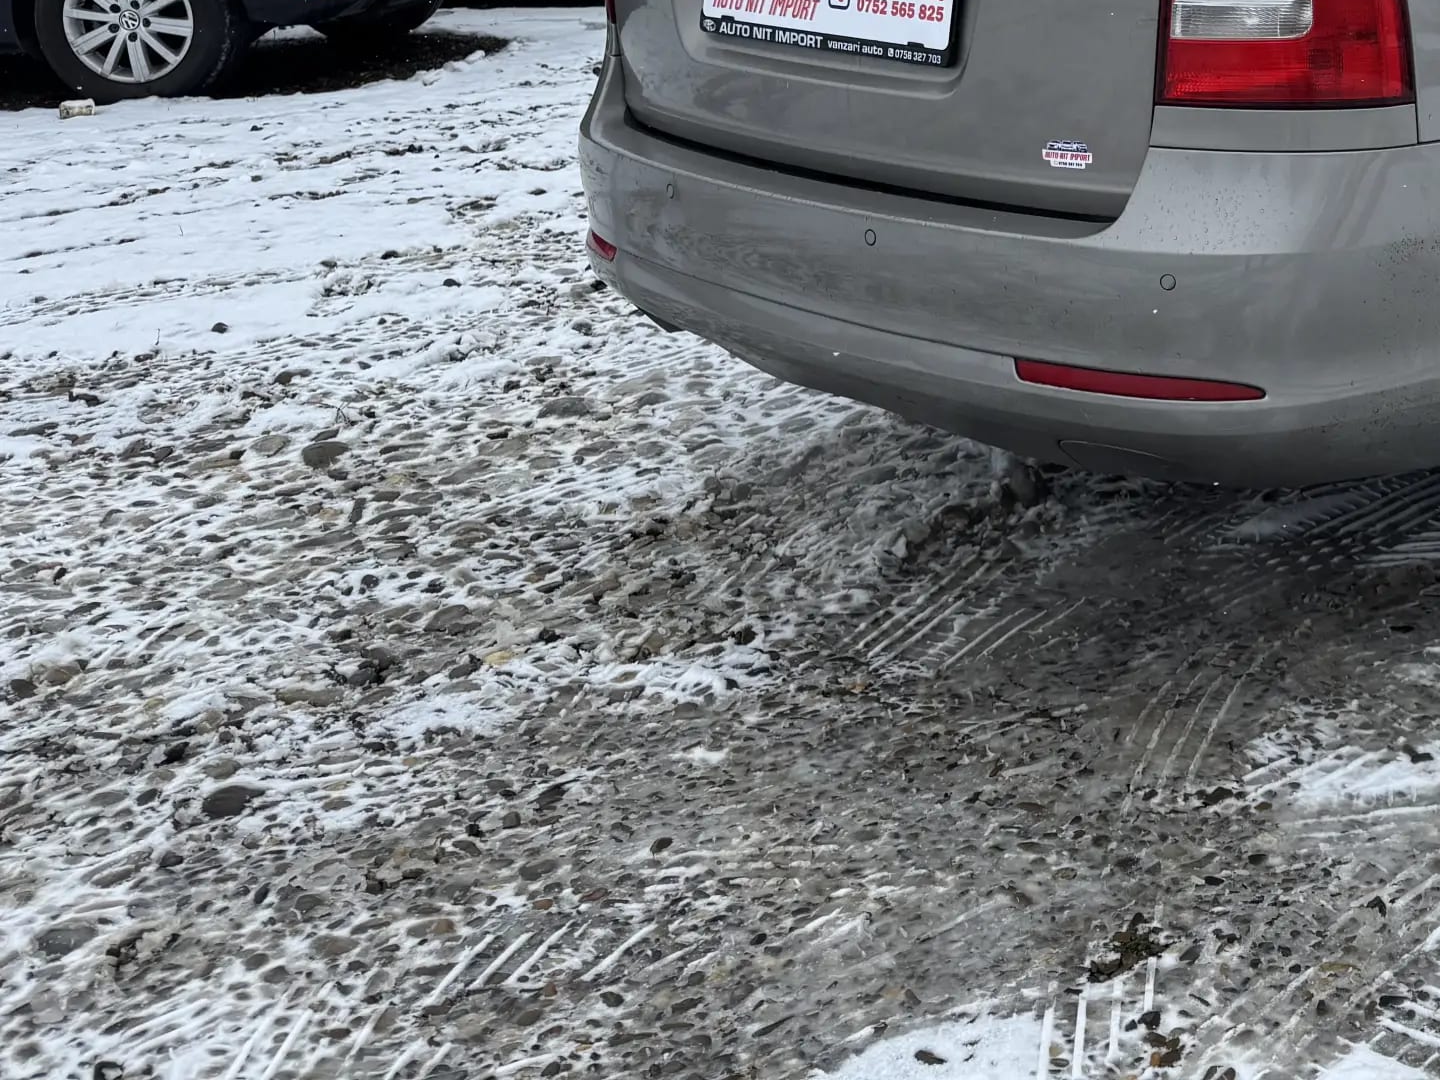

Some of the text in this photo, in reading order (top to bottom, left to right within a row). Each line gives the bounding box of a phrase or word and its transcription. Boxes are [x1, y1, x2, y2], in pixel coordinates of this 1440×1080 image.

[891, 0, 915, 18] 565
[918, 4, 944, 22] 825
[719, 22, 750, 37] AUTO
[752, 27, 774, 41] NIT
[775, 30, 823, 48] IMPORT
[827, 40, 861, 53] vanzari
[862, 46, 883, 56] auto
[913, 52, 927, 63] 327
[928, 54, 941, 65] 703
